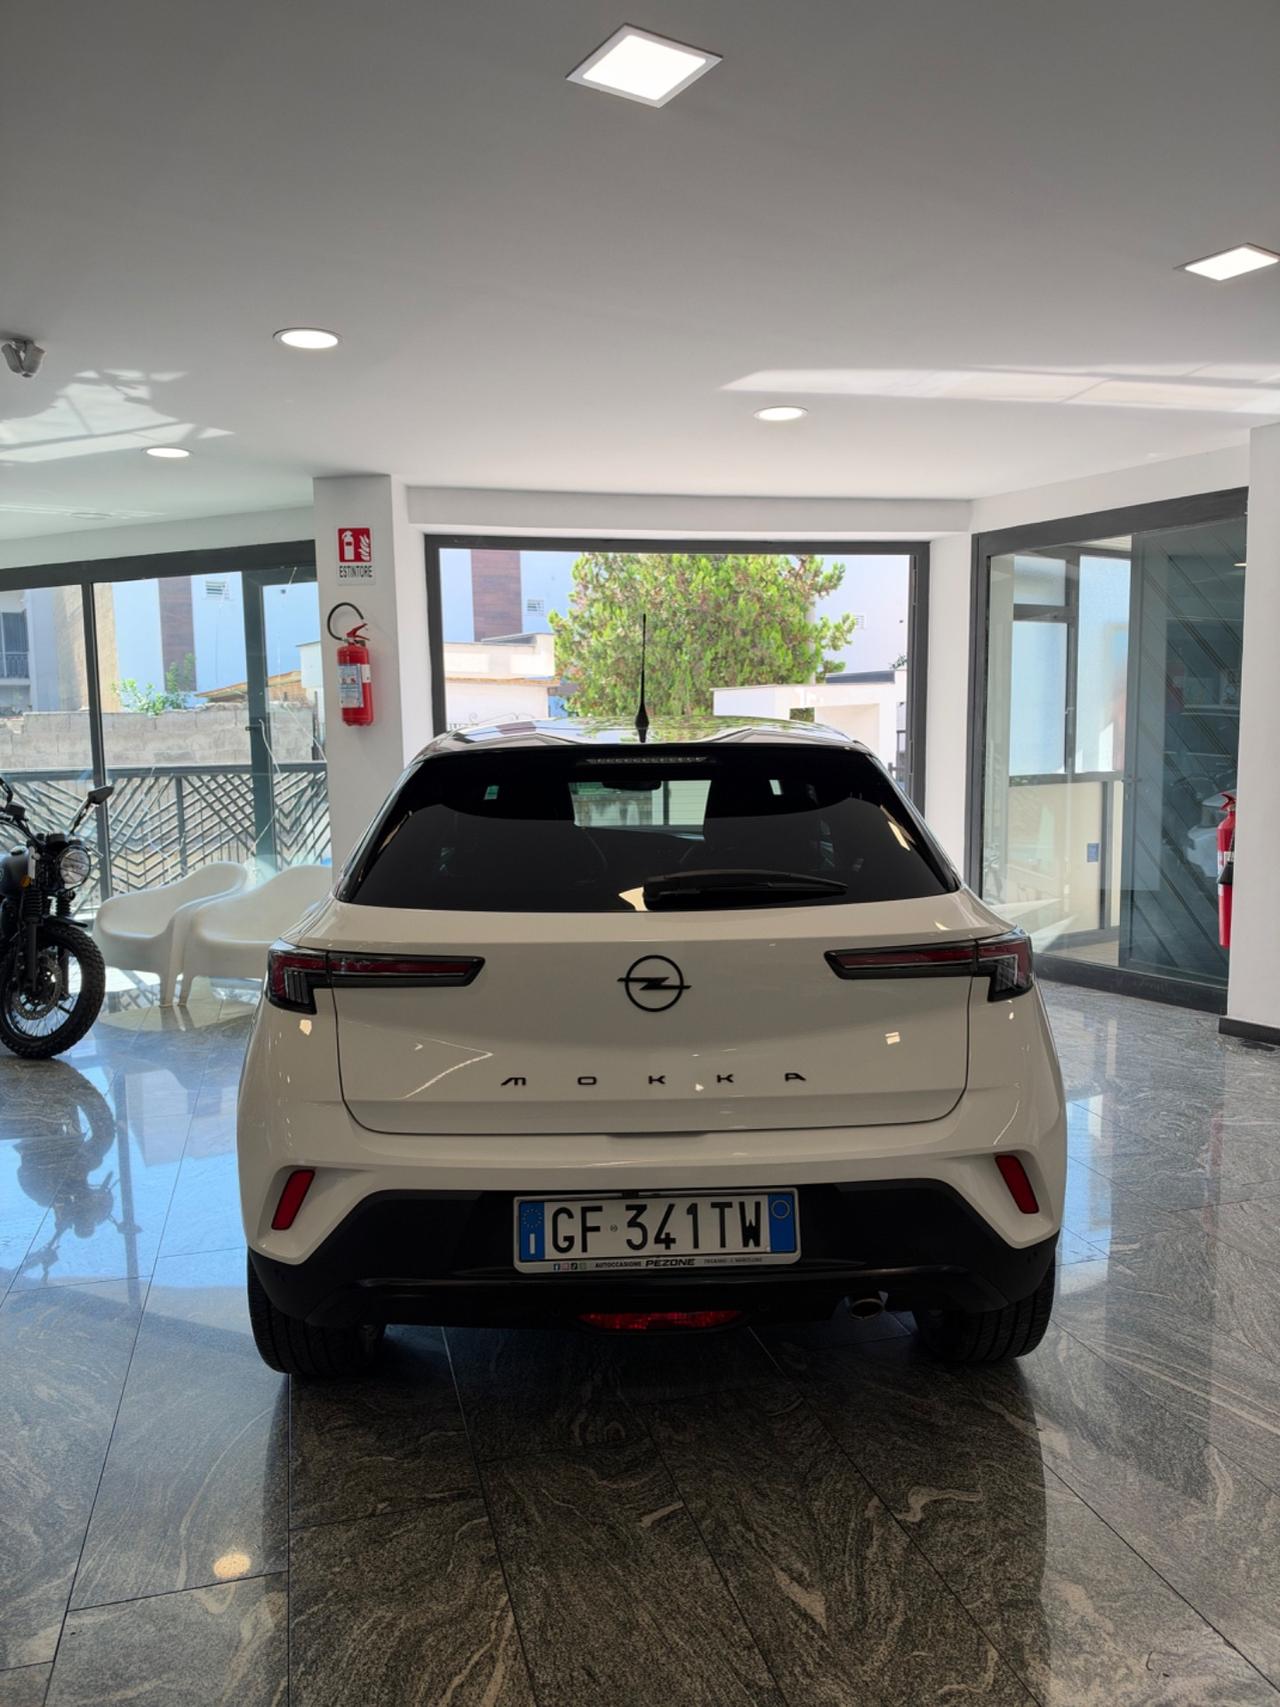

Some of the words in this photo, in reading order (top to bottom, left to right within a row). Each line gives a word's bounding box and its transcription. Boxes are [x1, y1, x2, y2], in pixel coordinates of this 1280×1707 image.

[339, 565, 373, 578] ESTINTORE
[501, 1071, 806, 1087] MOKKA
[551, 1204, 603, 1254] GF
[625, 1200, 762, 1251] 341TW
[645, 1258, 696, 1267] PEZONE
